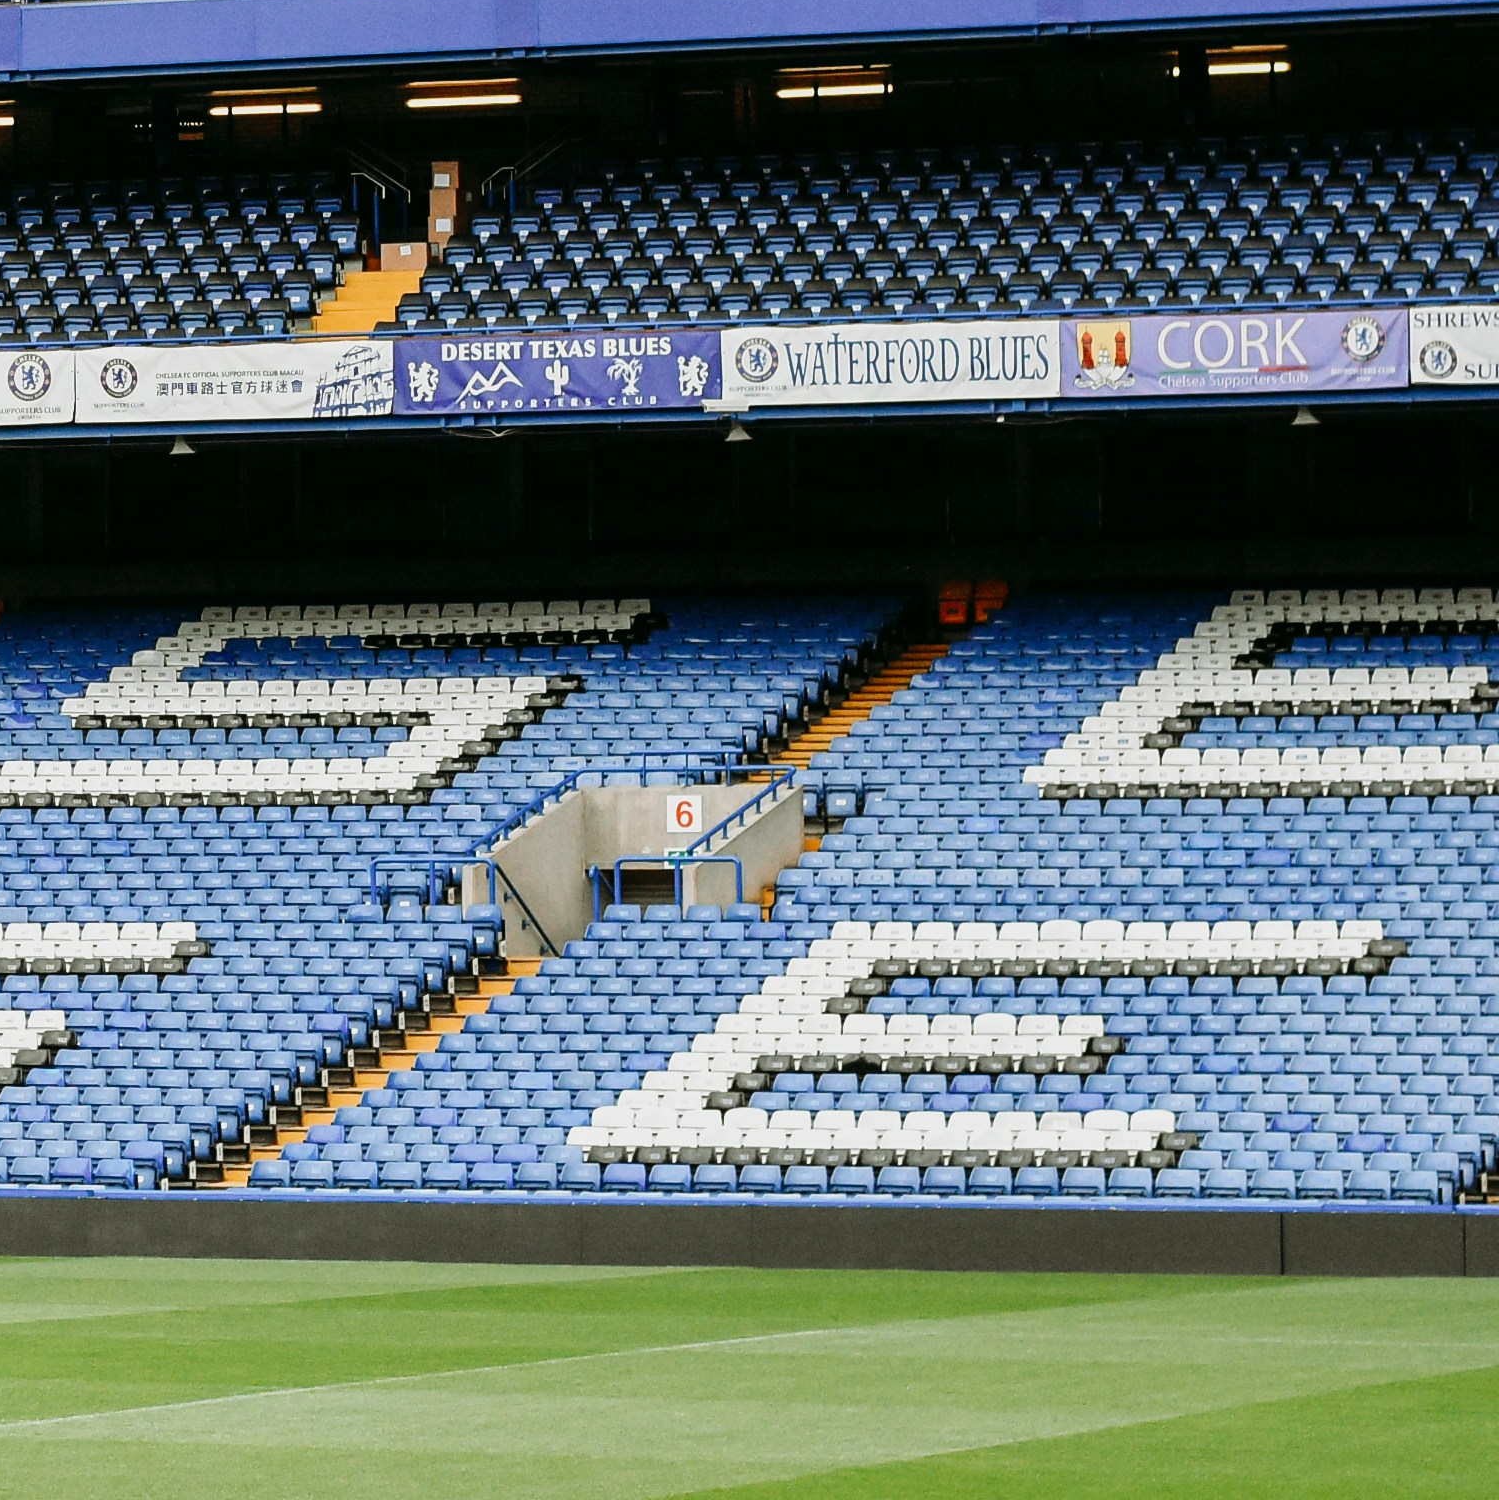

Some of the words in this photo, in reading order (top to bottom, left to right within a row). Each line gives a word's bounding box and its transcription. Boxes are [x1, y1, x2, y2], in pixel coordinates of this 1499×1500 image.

[441, 341, 524, 362] DESERT
[528, 339, 596, 360] TEXAS
[603, 336, 672, 357] BLUES
[1157, 318, 1307, 369] CORK
[14, 354, 44, 367] CHELSEA
[784, 332, 960, 387] WATERFORD
[968, 334, 1050, 382] BLUES
[221, 370, 261, 378] SUPPORTERS
[1159, 374, 1206, 388] Chelsea
[1209, 374, 1277, 389] Supporters
[1279, 372, 1309, 385] Club
[156, 379, 303, 397] 澳門車路士官方球迷會
[44, 406, 62, 414] CLUB
[459, 397, 592, 410] SUPPORTERS
[607, 395, 658, 407] CLUB
[676, 800, 694, 828] 6
